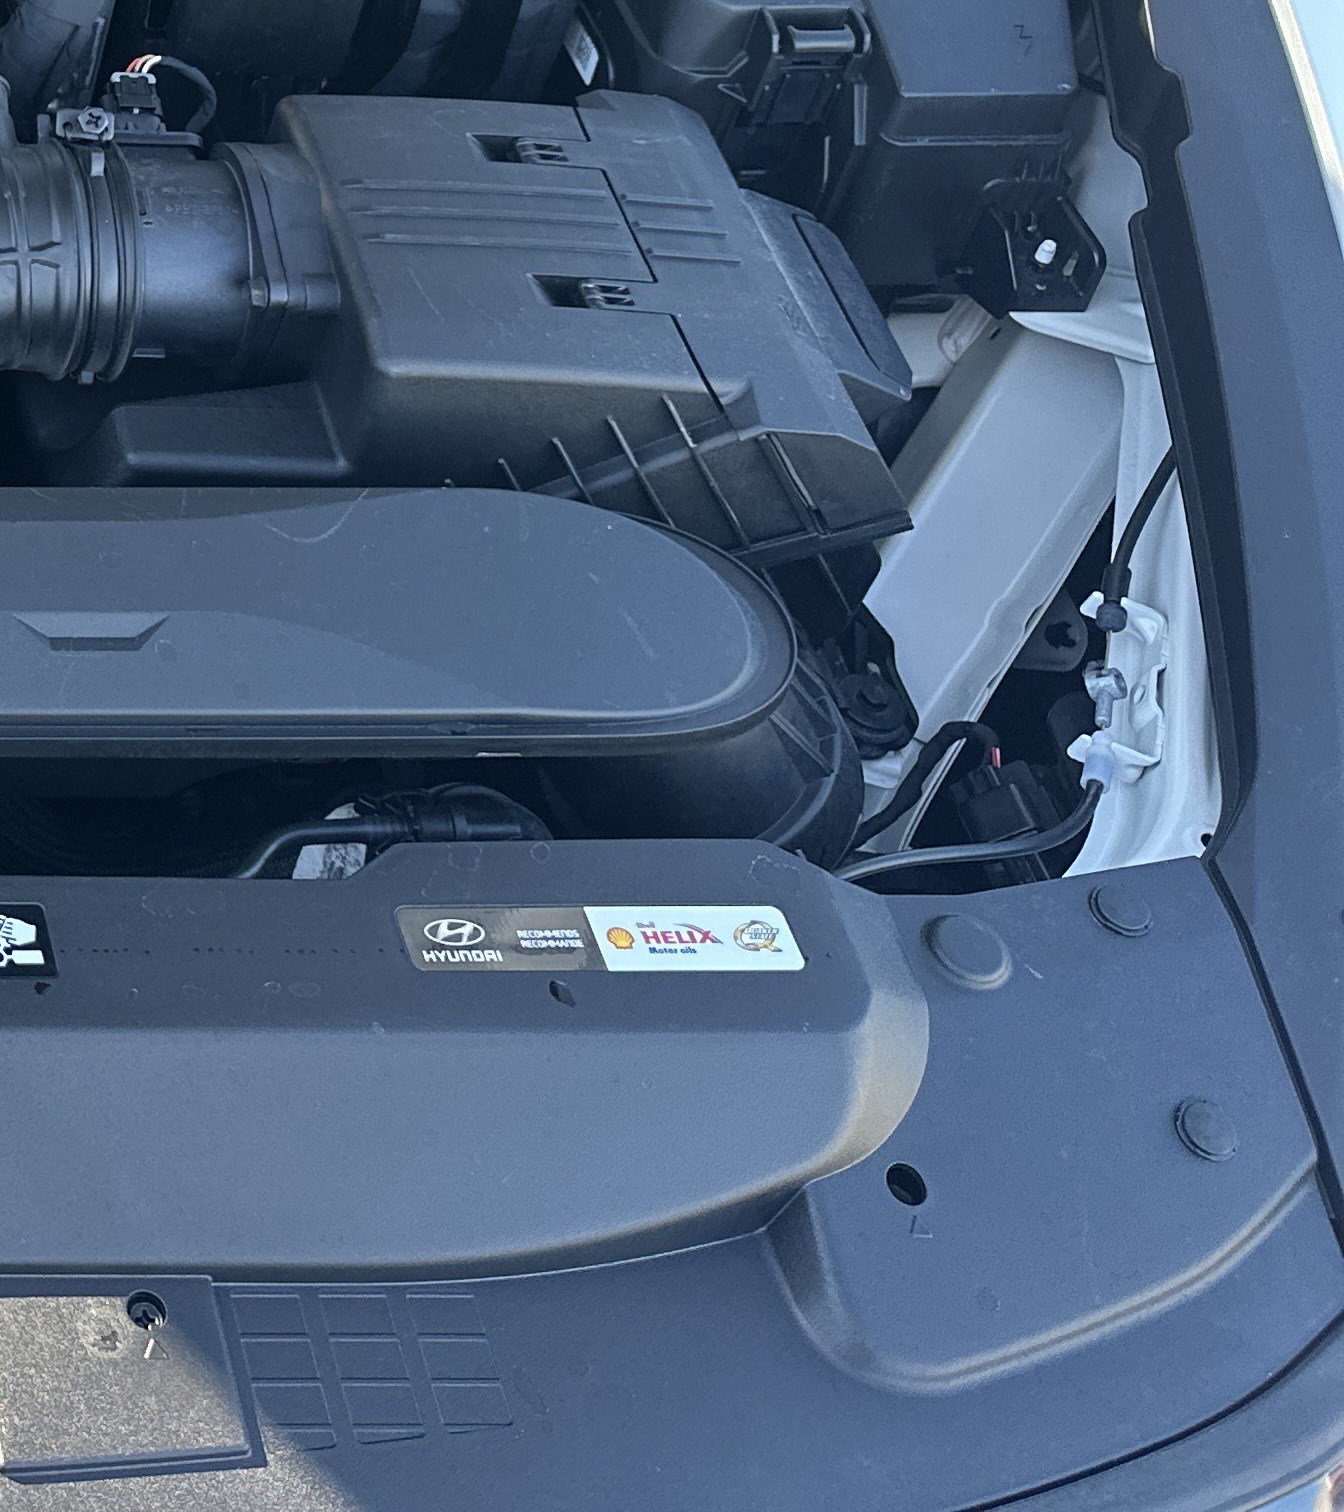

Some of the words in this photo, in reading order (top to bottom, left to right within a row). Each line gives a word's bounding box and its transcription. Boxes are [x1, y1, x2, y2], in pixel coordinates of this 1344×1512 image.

[640, 930, 717, 945] HELIX
[422, 949, 504, 963] HYUNDAI
[649, 946, 678, 955] Motor
